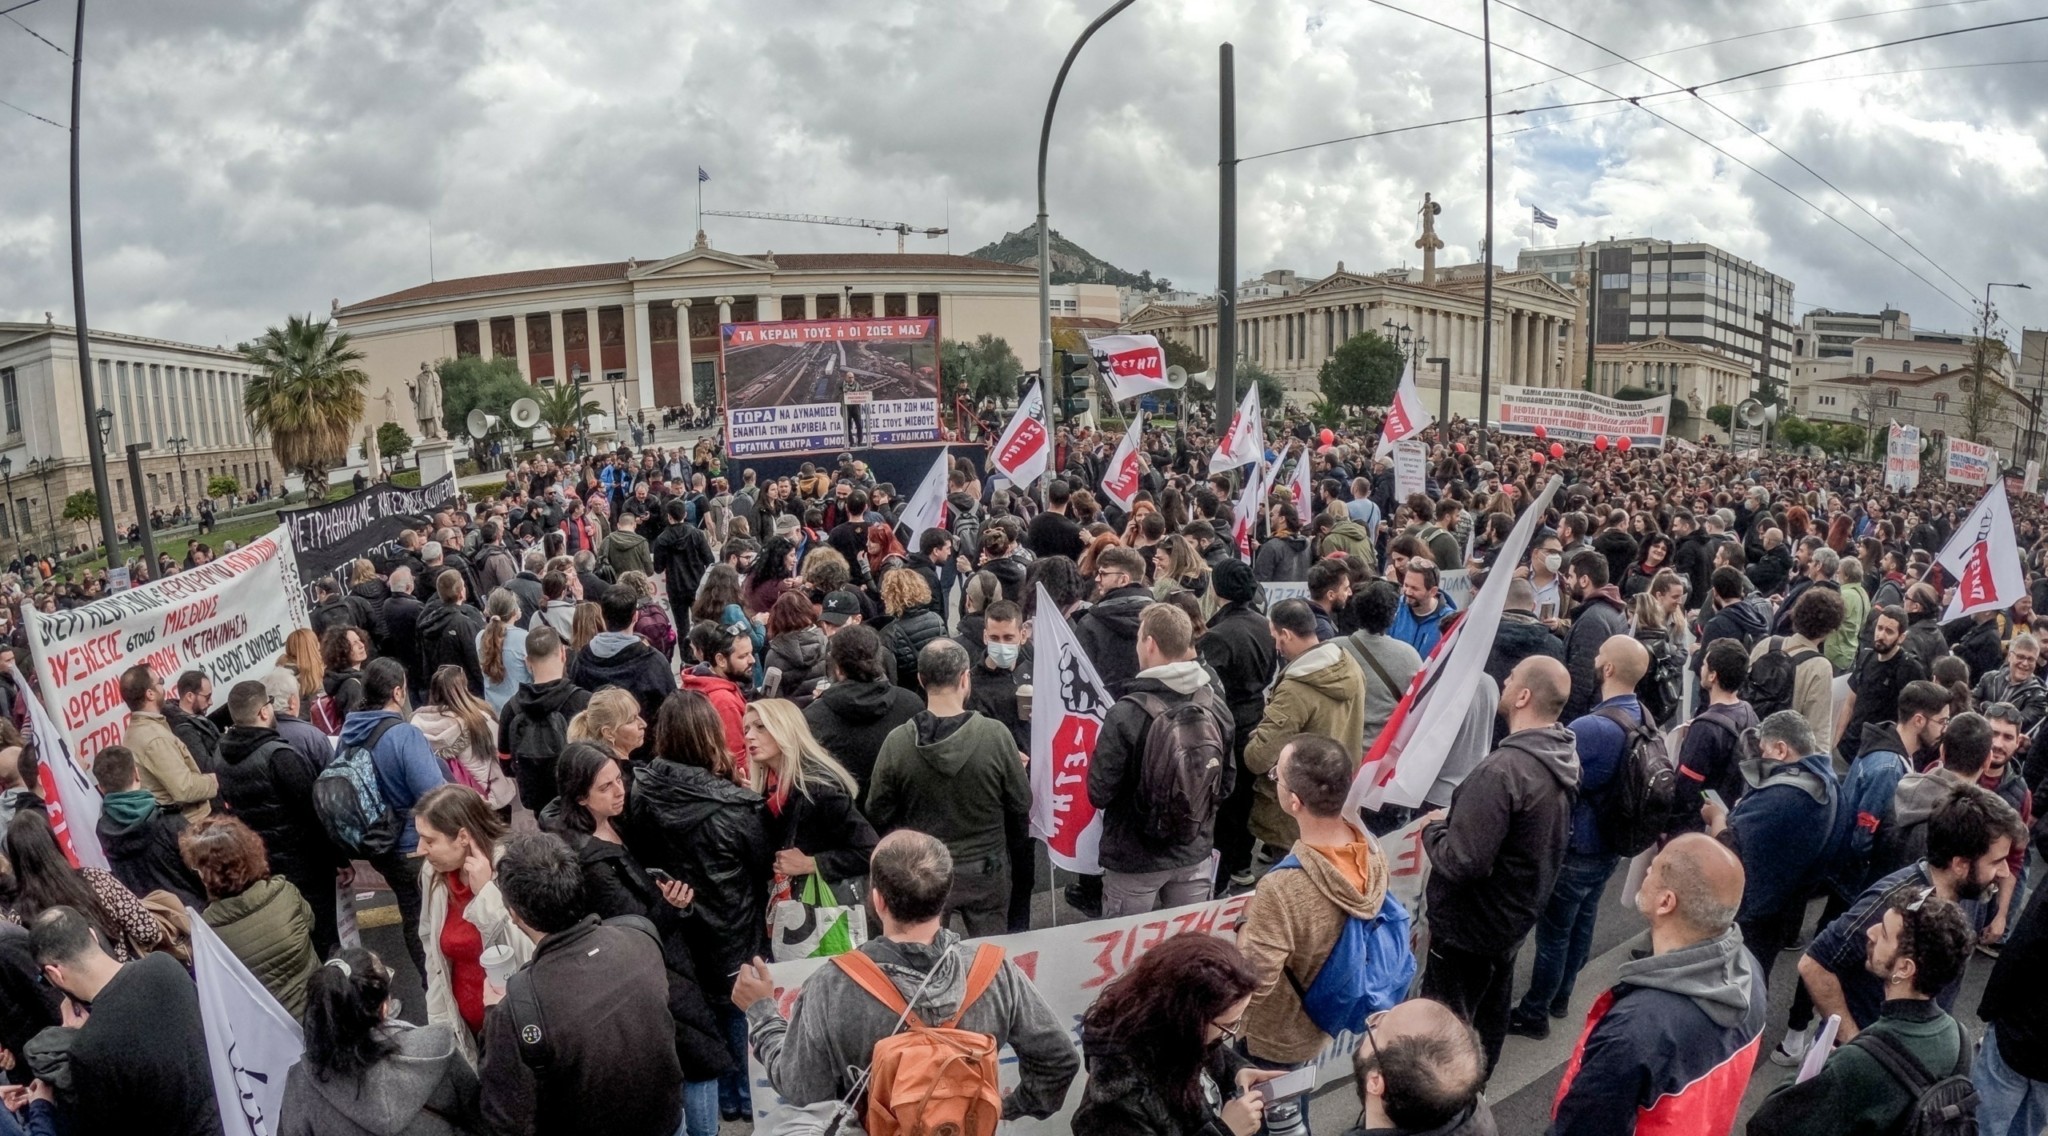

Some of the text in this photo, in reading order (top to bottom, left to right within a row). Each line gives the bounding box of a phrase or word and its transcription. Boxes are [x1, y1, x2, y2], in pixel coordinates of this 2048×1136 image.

[739, 324, 922, 341] ΤΑ ΚΕΡΔΗ ΤΟΥΣ ή ΟΙ ΖΩΕΣ ΜΑΣ
[732, 426, 767, 438] ΕΝΑΝΤΙΑ
[770, 425, 788, 436] ΣΤΗΝ
[791, 421, 830, 434] ΑΚΡΙΒΕΙΑ
[830, 421, 842, 432] ΓΙΑ
[882, 418, 902, 428] ΣΤΟΥΣ
[904, 415, 934, 426] ΜΙΣΘΟΥΣ
[735, 410, 773, 423] ΤΩΡΑ
[779, 409, 791, 420] ΝΑ
[793, 406, 837, 419] ΔΥΝΑΜΩΣΕΙ
[878, 403, 890, 414] ΓΙΑ
[893, 403, 902, 413] ΤΗ
[904, 402, 917, 413] ΖΩΗ
[920, 401, 934, 412] ΜΑΣ
[735, 441, 775, 453] ΕΡΓΑΤΙΚΑ
[779, 439, 812, 449] ΚΕΝΤΡΑ
[891, 431, 934, 442] ΣΥΝΔΙΚΑΤΑ
[284, 494, 375, 553] ΜΕΤΡΗΘΗΚΑΜΕ
[162, 594, 219, 637] ΜΙΣΘΟΥΣ
[181, 612, 248, 663] ΜΕΤΑΚΙΝΗΣΗ
[79, 720, 123, 758] ΕΤΡΑ
